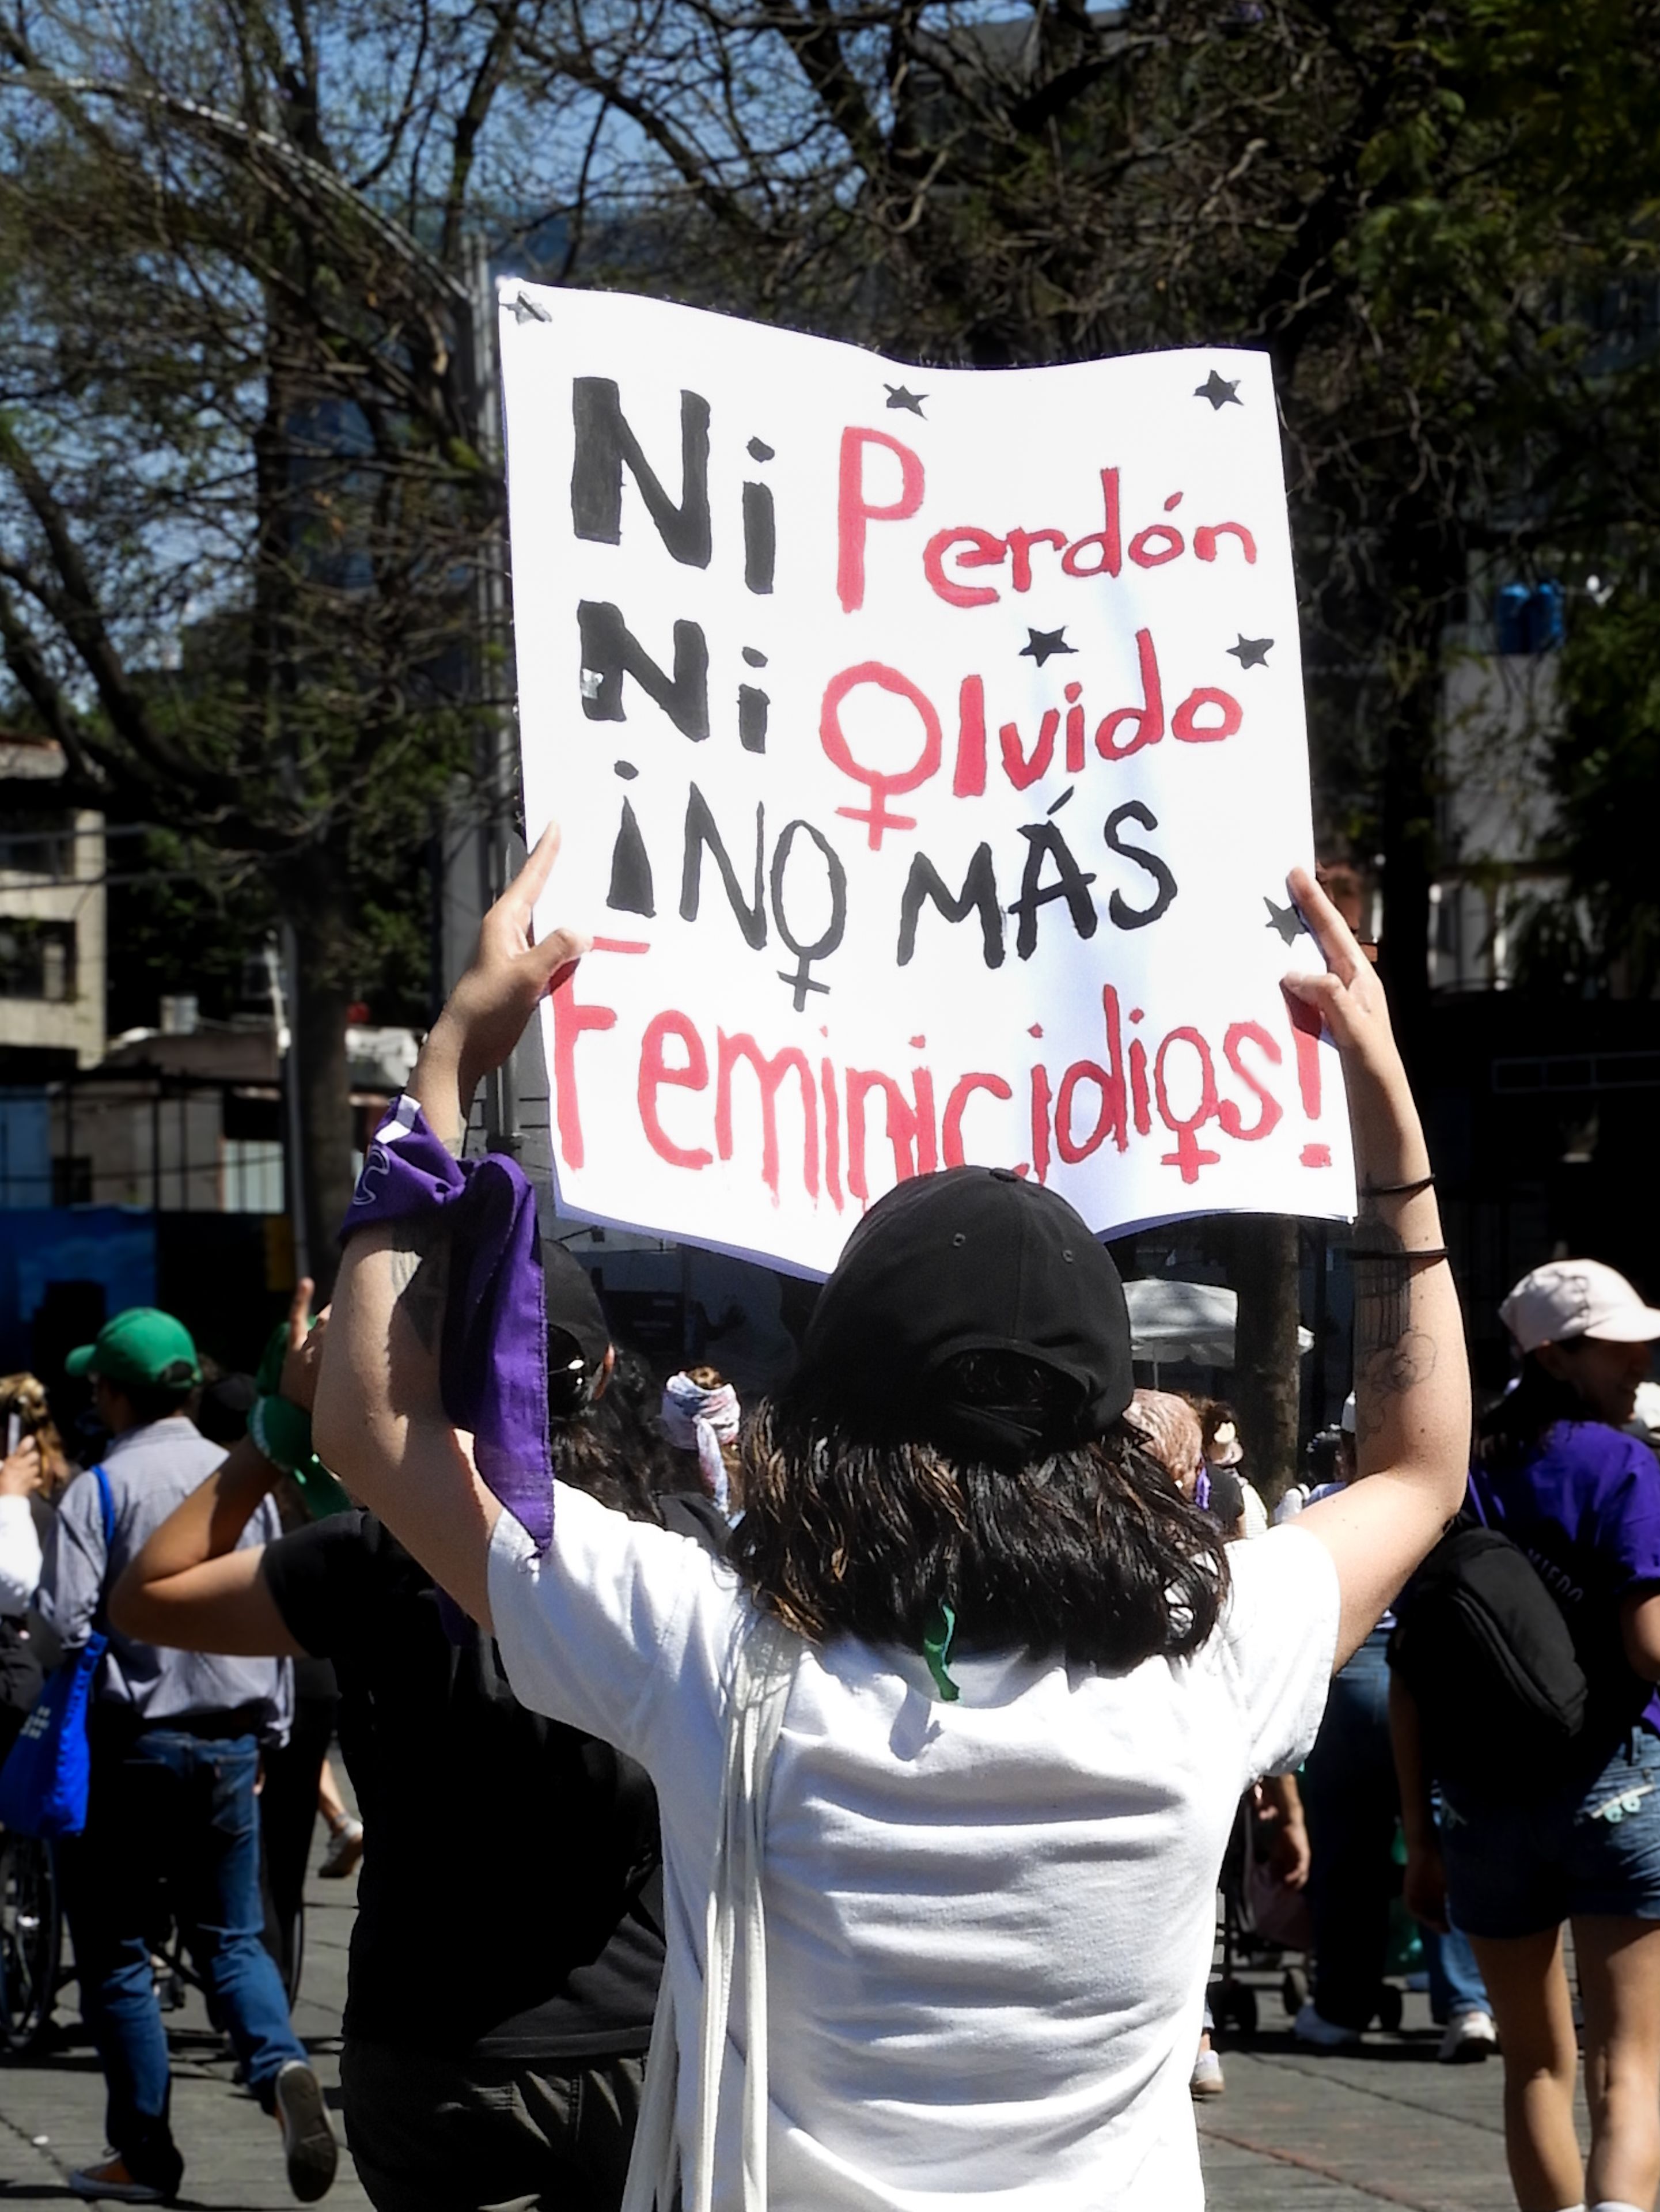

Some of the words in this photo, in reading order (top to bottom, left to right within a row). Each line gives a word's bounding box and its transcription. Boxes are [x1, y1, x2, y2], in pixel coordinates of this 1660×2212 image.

[571, 377, 776, 594] Ni
[836, 426, 1258, 613] Perdón
[577, 599, 770, 753] Ni
[819, 628, 1243, 851] Olvido
[897, 785, 1178, 969] MÁS
[549, 935, 1332, 1215] Feminicidios!
